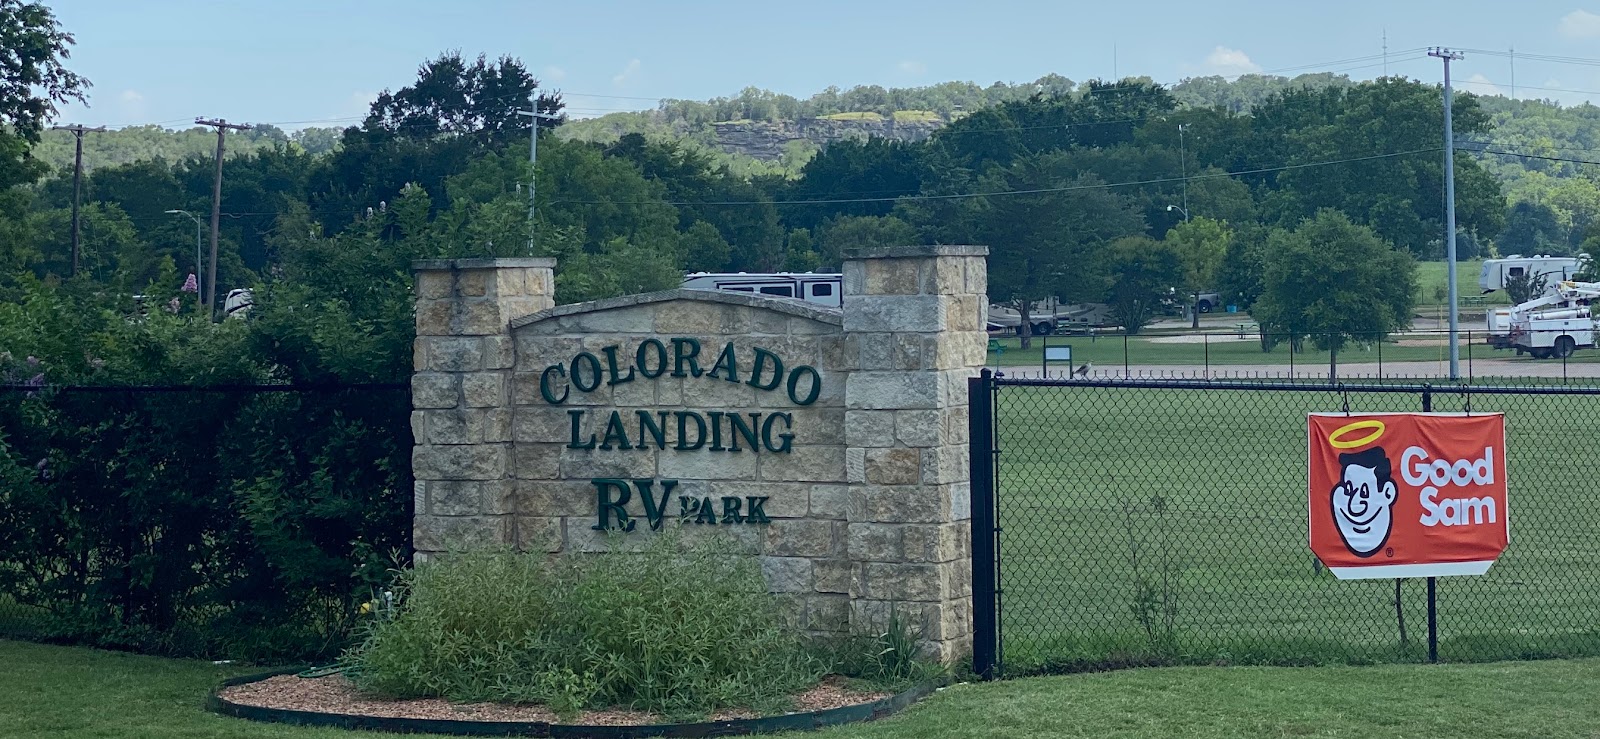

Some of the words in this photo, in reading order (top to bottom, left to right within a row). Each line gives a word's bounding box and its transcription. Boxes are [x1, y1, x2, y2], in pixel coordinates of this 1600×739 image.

[540, 337, 821, 406] COLORADO
[566, 410, 795, 454] LANDING
[1401, 446, 1494, 487] Good
[591, 477, 679, 532] RV
[679, 495, 771, 525] PARK
[1419, 486, 1496, 527] Sam
